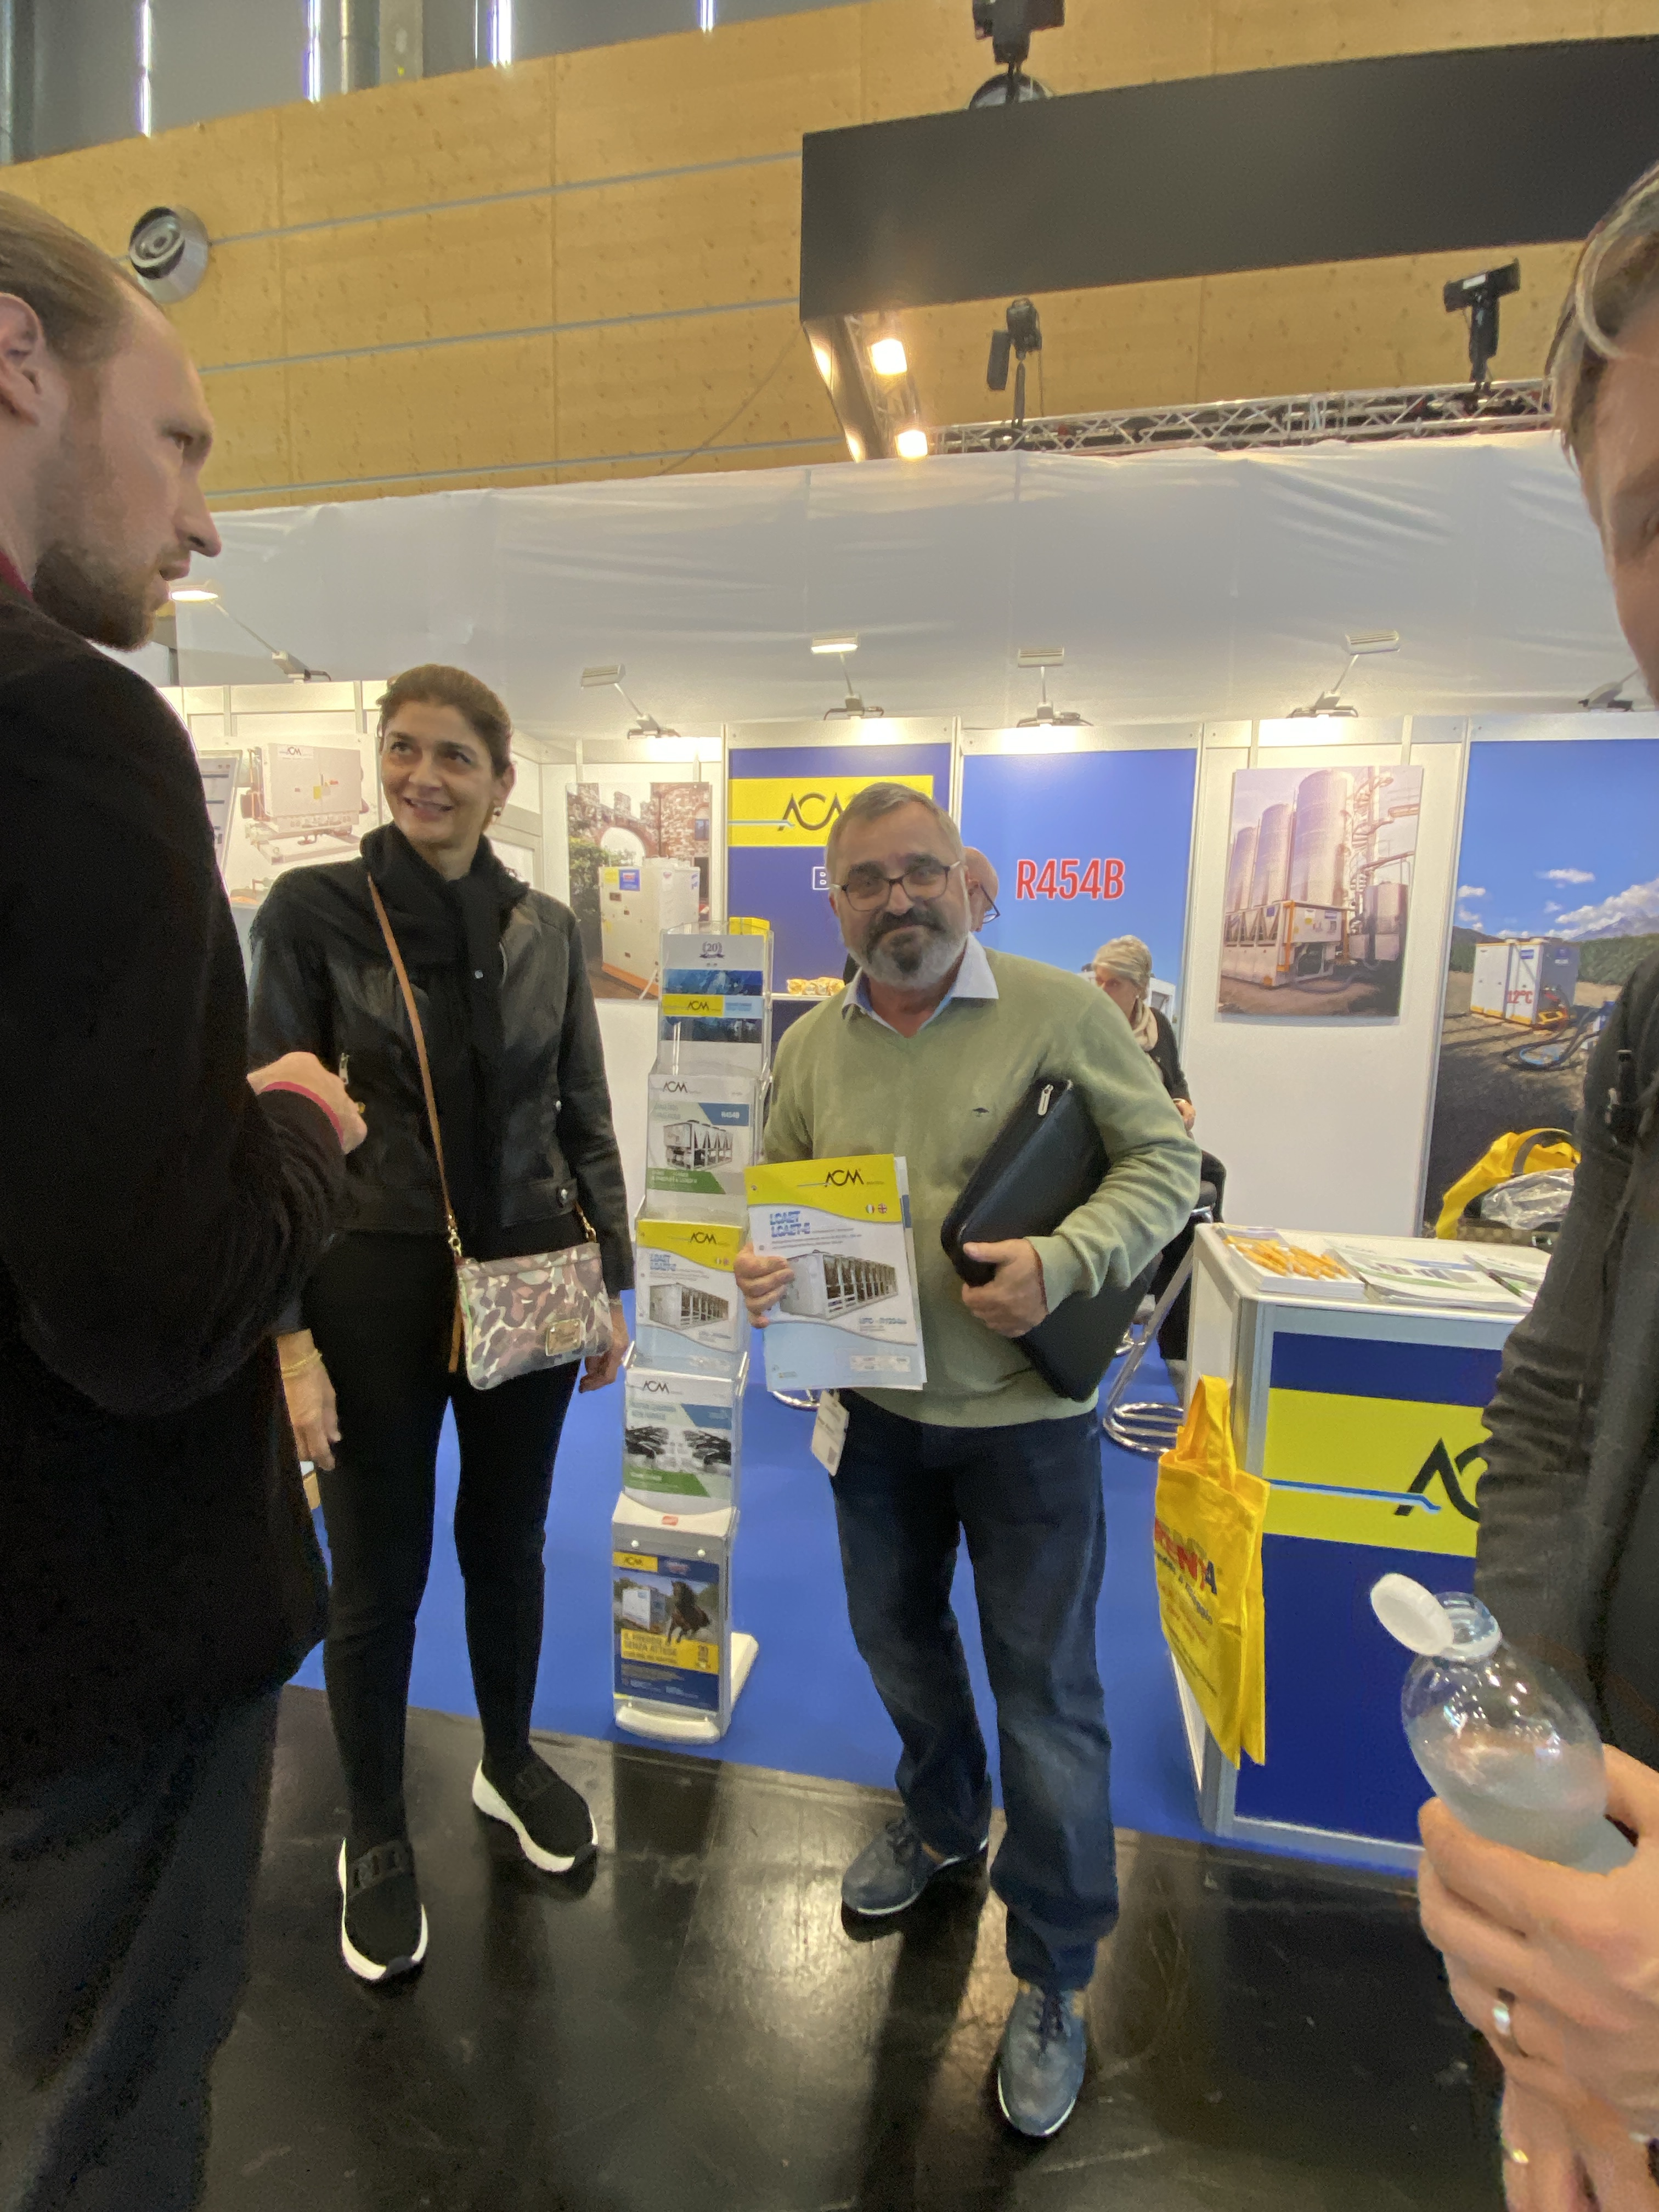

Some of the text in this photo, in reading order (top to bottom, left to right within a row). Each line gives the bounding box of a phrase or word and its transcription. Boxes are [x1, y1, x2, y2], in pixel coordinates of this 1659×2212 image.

[1015, 859, 1125, 900] R454B
[687, 1000, 709, 1011] ACM
[663, 1081, 688, 1093] ACM
[825, 1169, 864, 1188] ACM
[690, 1231, 716, 1245] ACM
[642, 1380, 670, 1394] ACM
